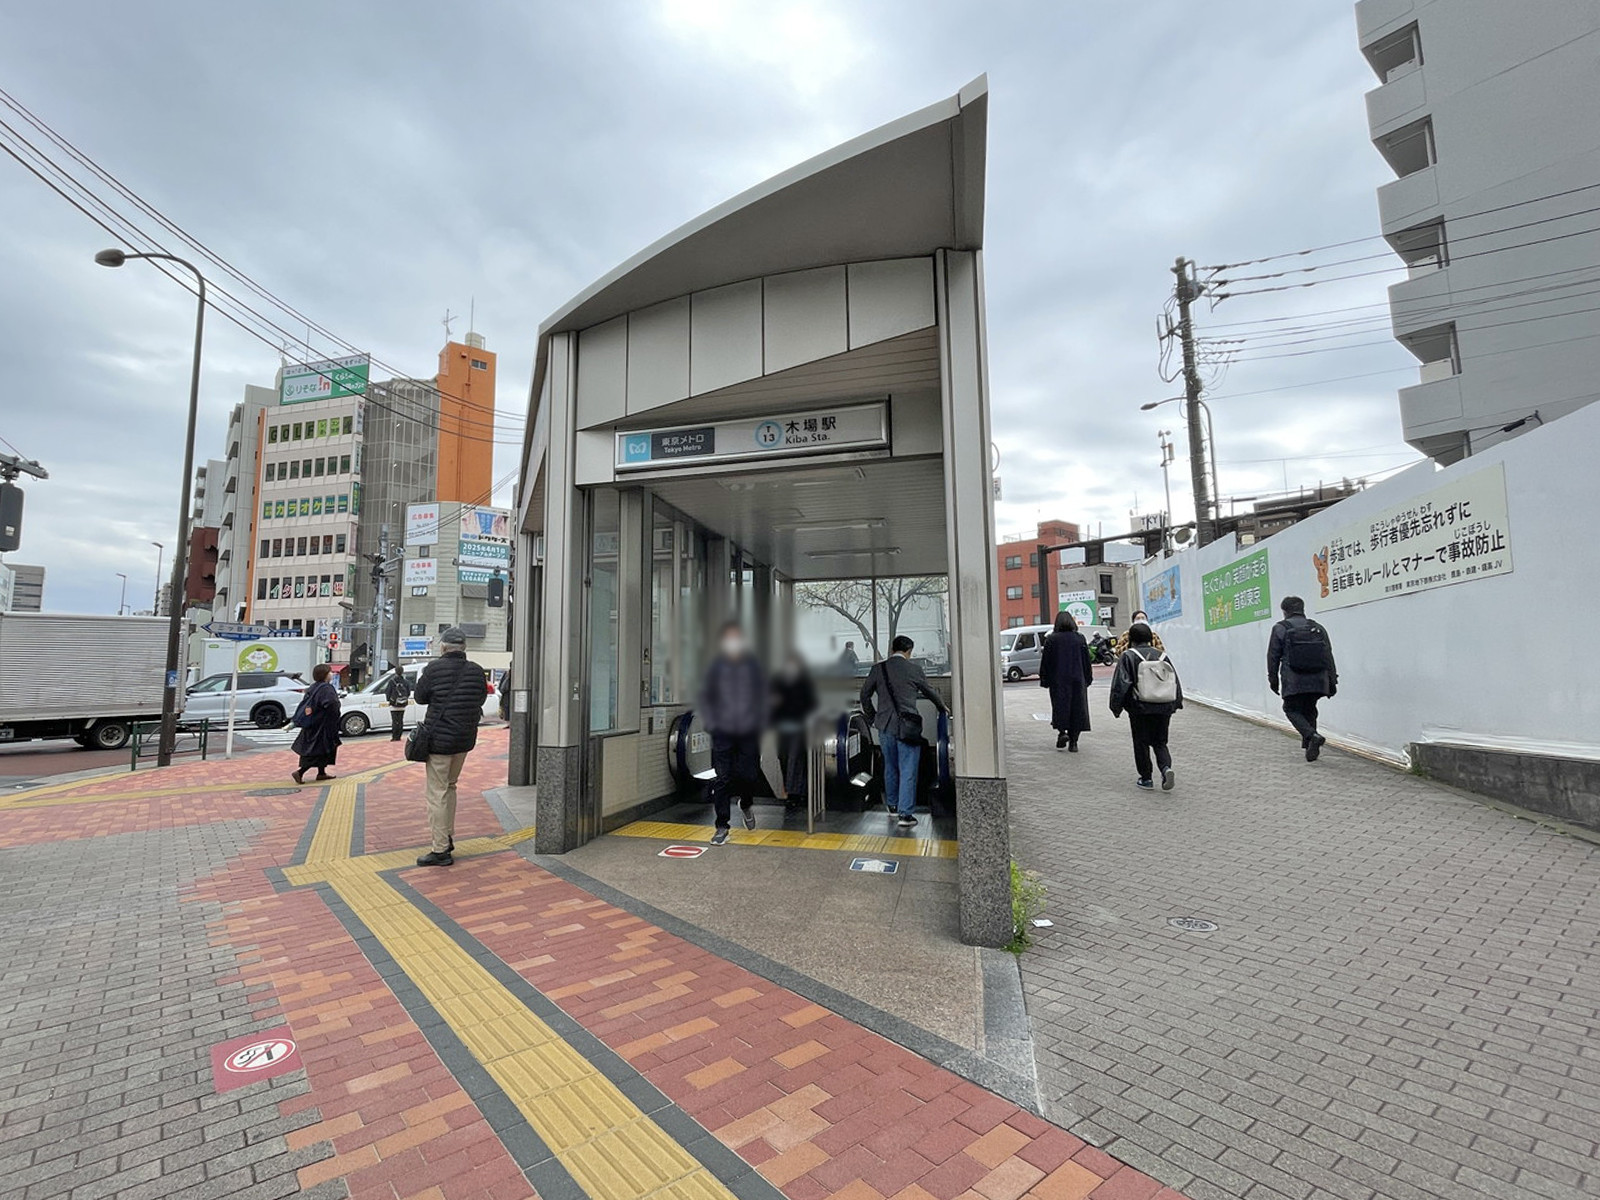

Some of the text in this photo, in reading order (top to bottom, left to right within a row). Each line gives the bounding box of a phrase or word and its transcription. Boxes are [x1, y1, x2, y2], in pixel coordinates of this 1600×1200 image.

[296, 384, 317, 394] りそな
[785, 416, 836, 434] 木場駅
[661, 434, 704, 446] 東京メトロ
[763, 434, 775, 442] 13
[785, 432, 831, 444] Kiba Sta.
[664, 446, 682, 454] Tokyo
[1370, 501, 1472, 551] 歩行者優先忘れずに
[1454, 520, 1491, 539] じこぼうし
[1332, 529, 1506, 592] 自転車もルールとマナーで事故防止
